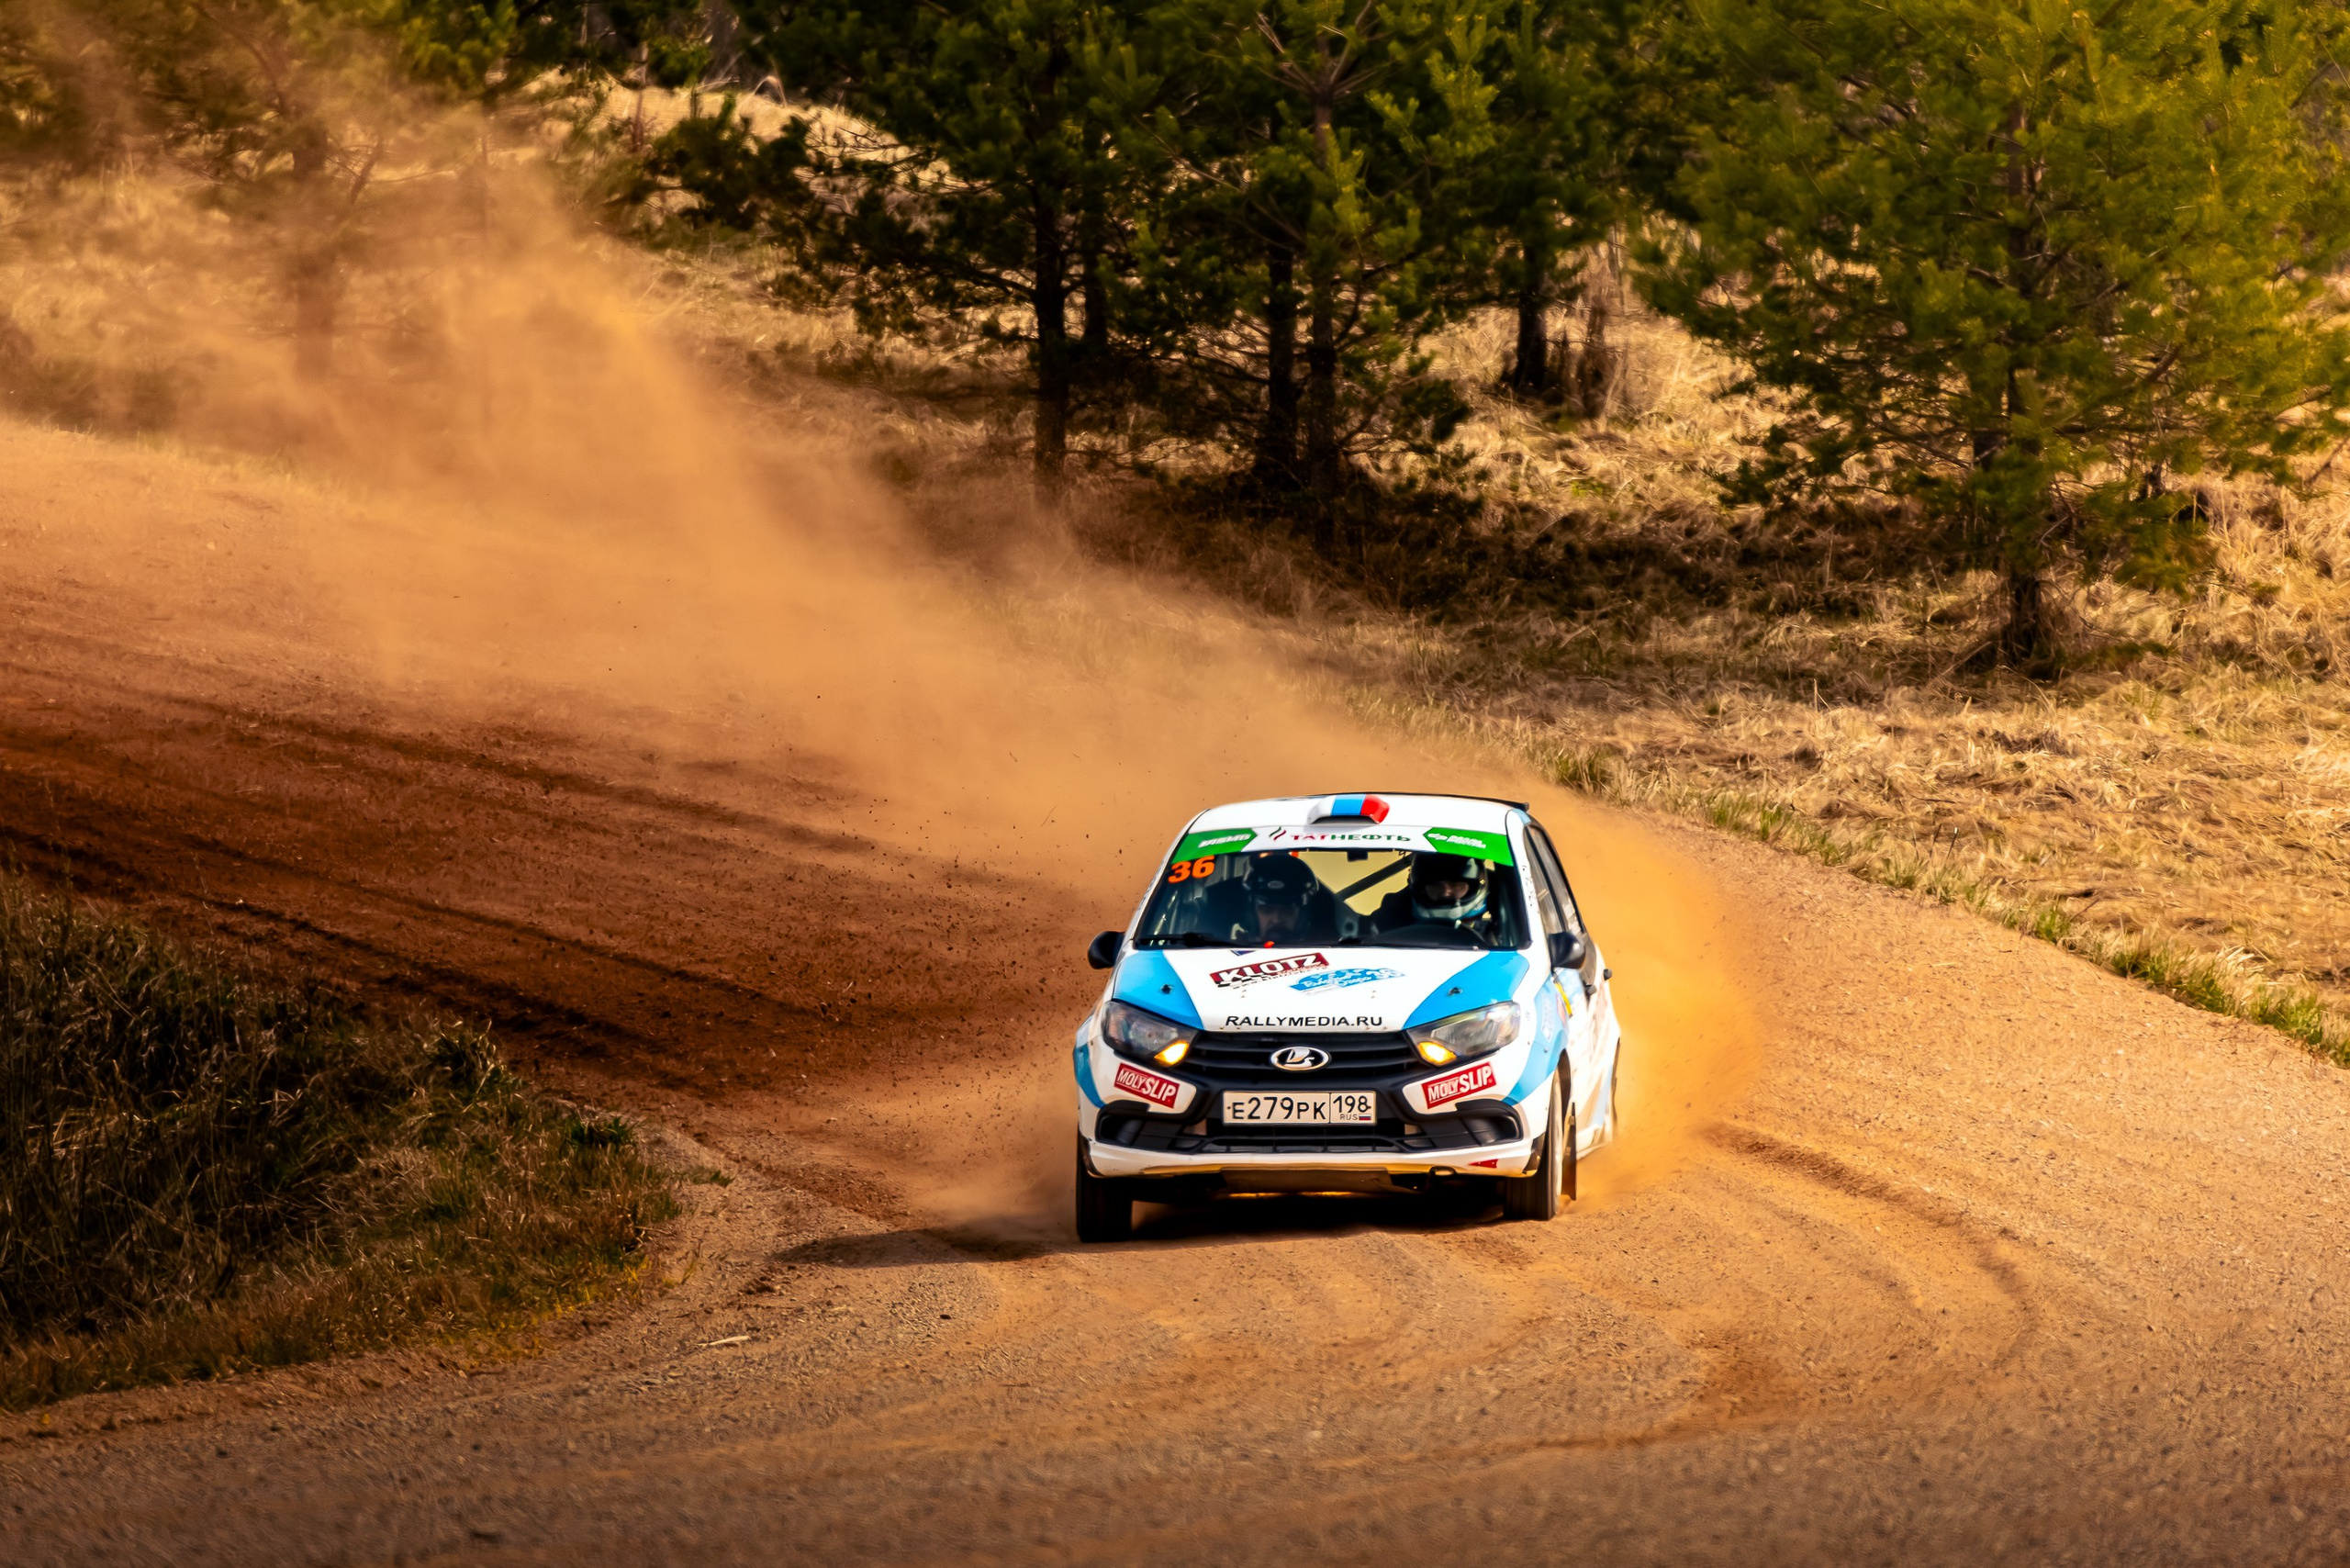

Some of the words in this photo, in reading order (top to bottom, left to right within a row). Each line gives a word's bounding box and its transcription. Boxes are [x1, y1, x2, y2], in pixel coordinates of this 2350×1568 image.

[1290, 834, 1411, 842] ТАТНЕФТЬ
[1168, 855, 1214, 883] 36
[1218, 955, 1322, 983] KLOTZ
[1225, 1015, 1382, 1026] RALLYMEDIA.RU
[1117, 1069, 1177, 1102] MOLYSLIP
[1427, 1065, 1492, 1102] MOLYSLIP
[1333, 1095, 1369, 1114] 198
